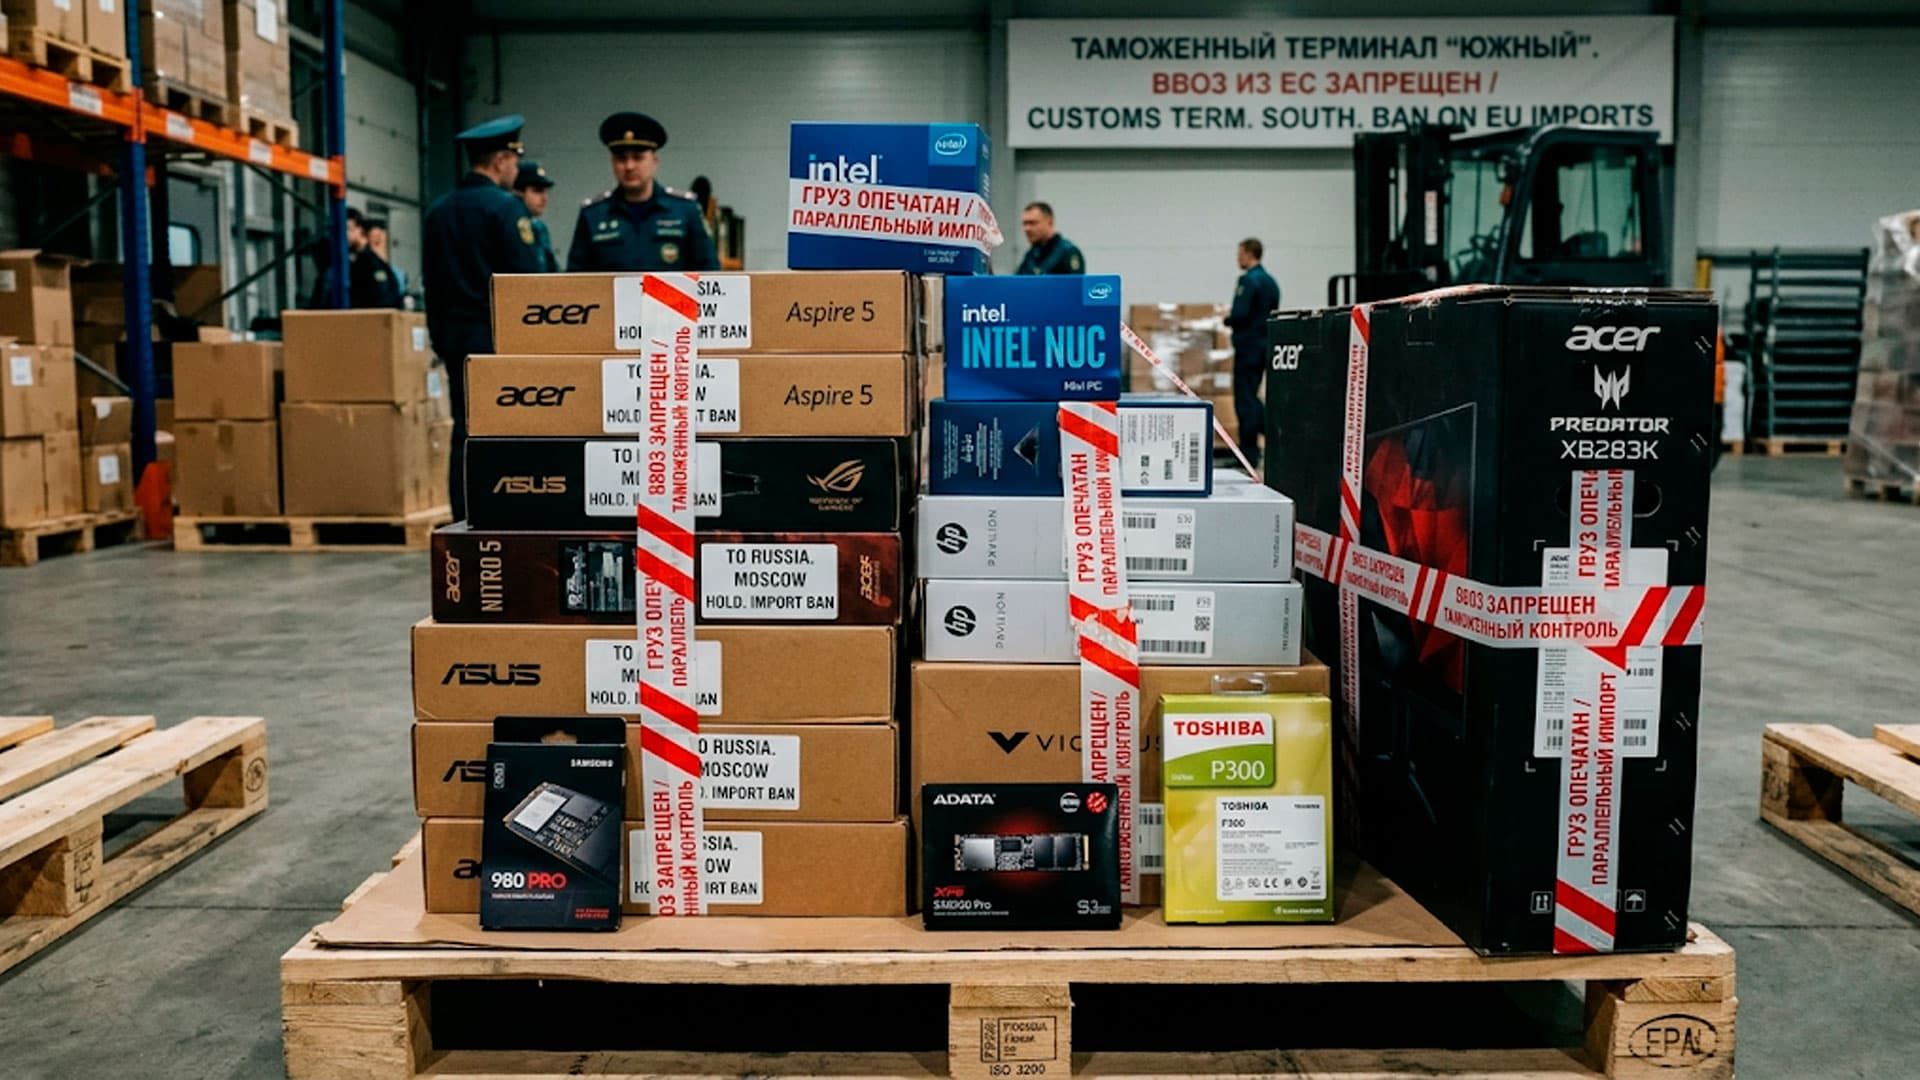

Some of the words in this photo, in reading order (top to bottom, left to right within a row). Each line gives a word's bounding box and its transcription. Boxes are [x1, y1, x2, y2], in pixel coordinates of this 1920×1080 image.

[1071, 31, 1276, 60] ТАМОЖЕННЫЙ
[1285, 37, 1438, 59] ТЕРМИНАЛ
[1152, 72, 1227, 95] ВВОЗ
[1236, 72, 1271, 95] ИЗ
[1280, 72, 1316, 95] ЕС
[1326, 71, 1482, 96] ЗАПРЕЩЕН
[1028, 107, 1161, 129] CUSTOMS
[1170, 107, 1252, 129] TERM.
[1262, 106, 1363, 129] SOUTH.
[1373, 106, 1429, 129] BAN
[1438, 106, 1476, 128] ON
[1486, 106, 1521, 128] EU
[1532, 105, 1654, 127] IMPORTS
[802, 186, 850, 207] ГРУЗ
[858, 190, 960, 216] ОПЕЧАТАН
[697, 281, 726, 296] SIA.
[521, 304, 600, 325] acer
[786, 301, 855, 328] Aspire
[861, 301, 875, 322] 5
[720, 325, 747, 338] BAN
[1565, 325, 1661, 351] acer
[962, 325, 1037, 368] INTEL
[1045, 324, 1106, 368] NUC
[496, 386, 576, 407] acer
[1087, 381, 1102, 391] PC
[649, 354, 669, 446] ЗАПРЕЩЕН
[783, 384, 853, 412] Aspire
[860, 384, 873, 405] 5
[606, 409, 641, 422] HOLD
[709, 408, 736, 422] BAN
[1550, 417, 1670, 435] PREDATOR
[613, 448, 632, 463] TO
[1560, 440, 1659, 460] XB283K
[493, 476, 567, 494] ASUS
[1071, 454, 1093, 536] ОПЕЧАТАН
[589, 492, 629, 506] HOLD.
[479, 540, 502, 552] 5
[936, 523, 968, 554] hp
[727, 549, 746, 564] TO
[751, 549, 814, 565] RUSSIA.
[1076, 543, 1096, 583] ГРУЗ
[480, 557, 503, 612] NITRO
[734, 572, 807, 587] MOSCOW
[706, 595, 747, 609] HOLD.
[751, 595, 802, 609] IMPORT
[807, 595, 835, 609] BAN
[1487, 595, 1595, 617] ЗАПРЕЩЕН
[944, 605, 977, 637] hp
[1444, 607, 1525, 639] ТАМОЖЕННЫЙ
[1529, 621, 1618, 639] КОНТРОЛЬ
[613, 645, 633, 661] TO
[646, 626, 664, 670] ГРУЗ
[441, 663, 541, 686] ASUS
[590, 691, 631, 705] HOLD.
[696, 692, 718, 705] AN
[1598, 672, 1618, 743] ИМПОРТ
[1173, 721, 1265, 736] TOSHIBA
[698, 738, 707, 754] O
[714, 739, 776, 756] RUSSIA.
[1090, 700, 1110, 783] АПРЕЩЕН
[1211, 760, 1265, 780] P300
[1569, 712, 1590, 807] ОПЕЧАТАН
[442, 760, 487, 783] AS
[712, 787, 764, 800] IMPORT
[768, 787, 795, 800] BAN
[933, 794, 995, 805] ADATA
[653, 791, 675, 888] ЗАПРЕЩЕН
[1567, 812, 1588, 858] ГРУЗ
[491, 872, 525, 889] 980
[528, 873, 567, 889] PRO
[731, 882, 757, 895] BAN
[990, 1065, 1011, 1075] ISO
